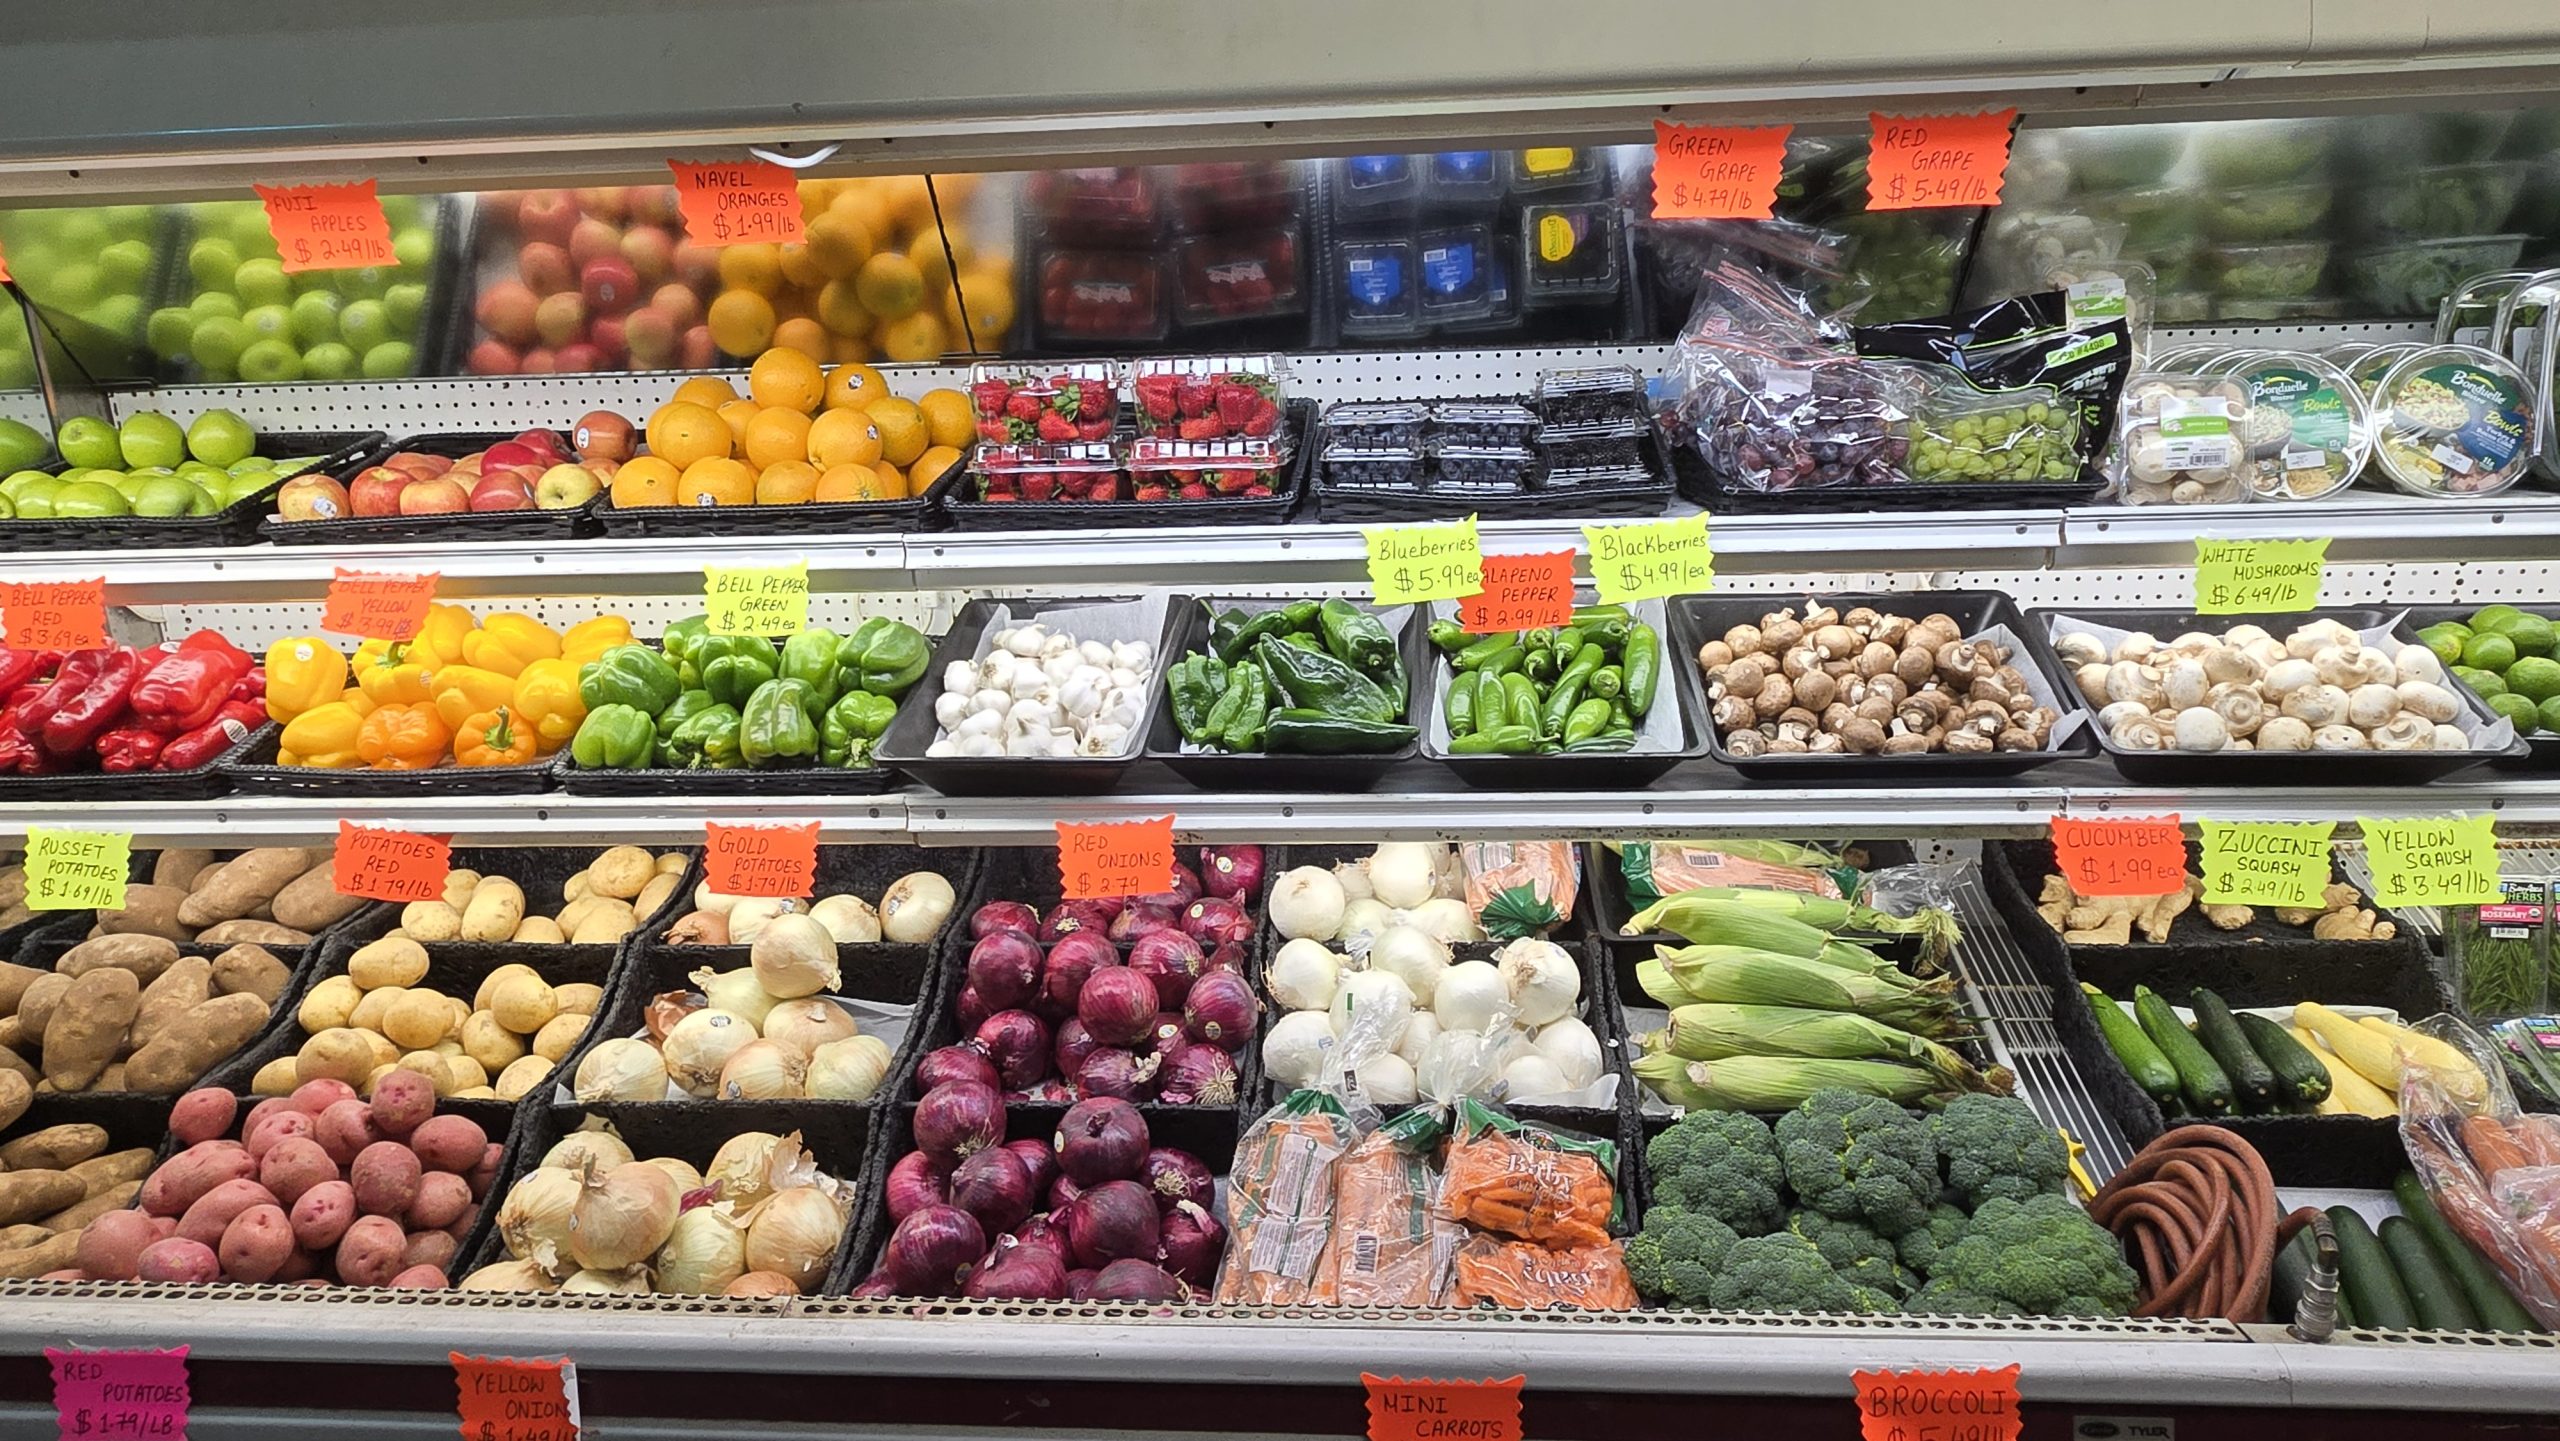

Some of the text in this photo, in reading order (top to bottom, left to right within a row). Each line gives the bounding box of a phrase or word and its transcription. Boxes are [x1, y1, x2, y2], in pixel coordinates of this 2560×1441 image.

[1669, 134, 1733, 158] GREEN
[1884, 126, 1928, 150] RED
[1911, 150, 1975, 170] GRAPE
[695, 171, 752, 189] NAVEL
[1700, 160, 1757, 182] GRAPE
[273, 195, 318, 213] FUJI
[718, 192, 789, 211] ORANGES
[311, 215, 367, 232] APPLES
[1378, 536, 1475, 561] Blueberries
[1600, 534, 1706, 561] Blackberries
[2202, 548, 2256, 564] WHITE
[1482, 567, 1553, 584] ALAPENO
[2234, 561, 2319, 581] MUSHROOMS
[382, 579, 429, 594] PEPPER
[717, 574, 806, 594] BELL PEPPER
[11, 588, 97, 607] BELL PEPPER
[740, 596, 789, 612] GREEN
[1502, 587, 1559, 602] PEPPER
[361, 598, 412, 614] YELLOW
[32, 610, 62, 626] RED
[350, 830, 435, 859] POTATOES
[718, 831, 769, 855] GOLD
[1073, 832, 1108, 853] RED
[2066, 827, 2173, 848] CUCUMBER
[2218, 830, 2323, 858] ZUCCINI
[2377, 829, 2454, 853] YELLOW
[38, 837, 106, 859] RUSSET
[364, 855, 400, 874] RED
[734, 856, 802, 874] POTATOES
[1097, 852, 1162, 869] ONIONS
[2237, 856, 2301, 877] SQUASH
[2405, 849, 2472, 869] SQAUSH
[47, 859, 118, 881] POTATOES
[2508, 893, 2543, 901] HERBS
[2480, 911, 2528, 919] ROSEMARY
[64, 1361, 103, 1381] RED
[103, 1383, 183, 1402] POTATOES
[472, 1372, 545, 1395] YELLOW
[1383, 1393, 1448, 1413] MINI
[1868, 1385, 2006, 1418] BROCCOLI
[1416, 1419, 1503, 1439] CARROTS
[2128, 1426, 2170, 1439] TYLER
